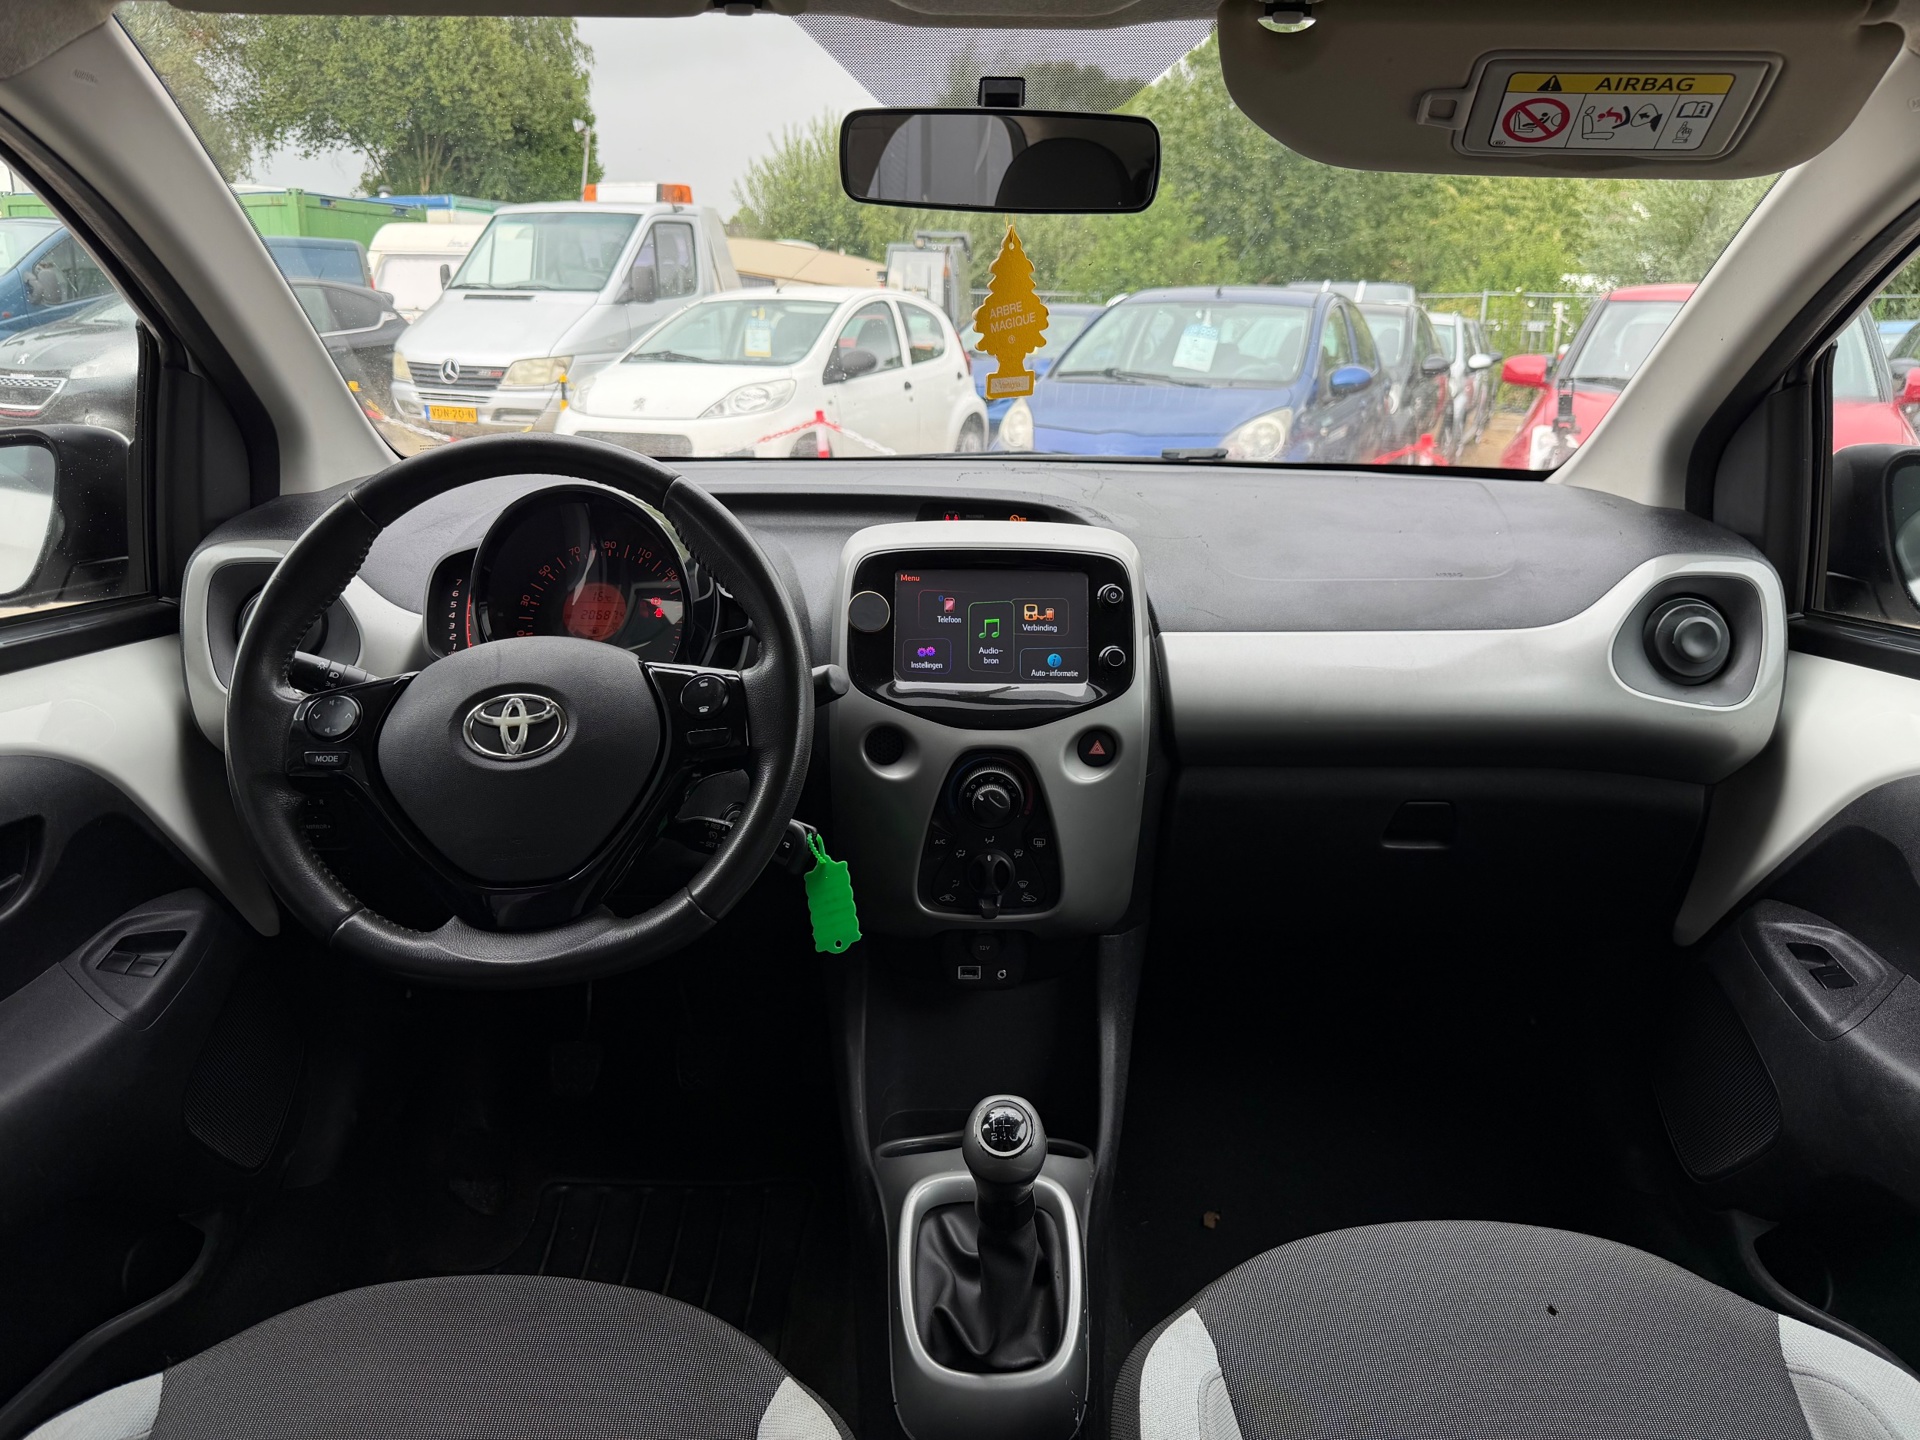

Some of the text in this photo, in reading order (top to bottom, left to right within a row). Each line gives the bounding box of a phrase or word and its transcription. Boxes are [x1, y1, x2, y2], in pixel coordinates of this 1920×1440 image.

[1594, 77, 1696, 92] AIRBAG
[990, 301, 1023, 319] ARBRE
[990, 312, 1036, 333] MAGIQUE
[604, 541, 617, 549] 90
[568, 546, 581, 556] 70
[637, 547, 653, 560] 110
[538, 564, 551, 577] 50
[665, 567, 678, 581] 130
[900, 574, 920, 582] Menu
[520, 594, 531, 607] 30
[448, 611, 456, 619] 4
[937, 615, 962, 624] Telefoon
[448, 622, 456, 630] 3
[1022, 623, 1058, 633] Verbinding
[449, 633, 457, 641] 2
[978, 646, 1004, 655] Audio-
[983, 656, 1000, 665] bron
[911, 661, 943, 671] Instellingen
[1030, 669, 1080, 678] Auto-informatie
[315, 755, 339, 763] MODE
